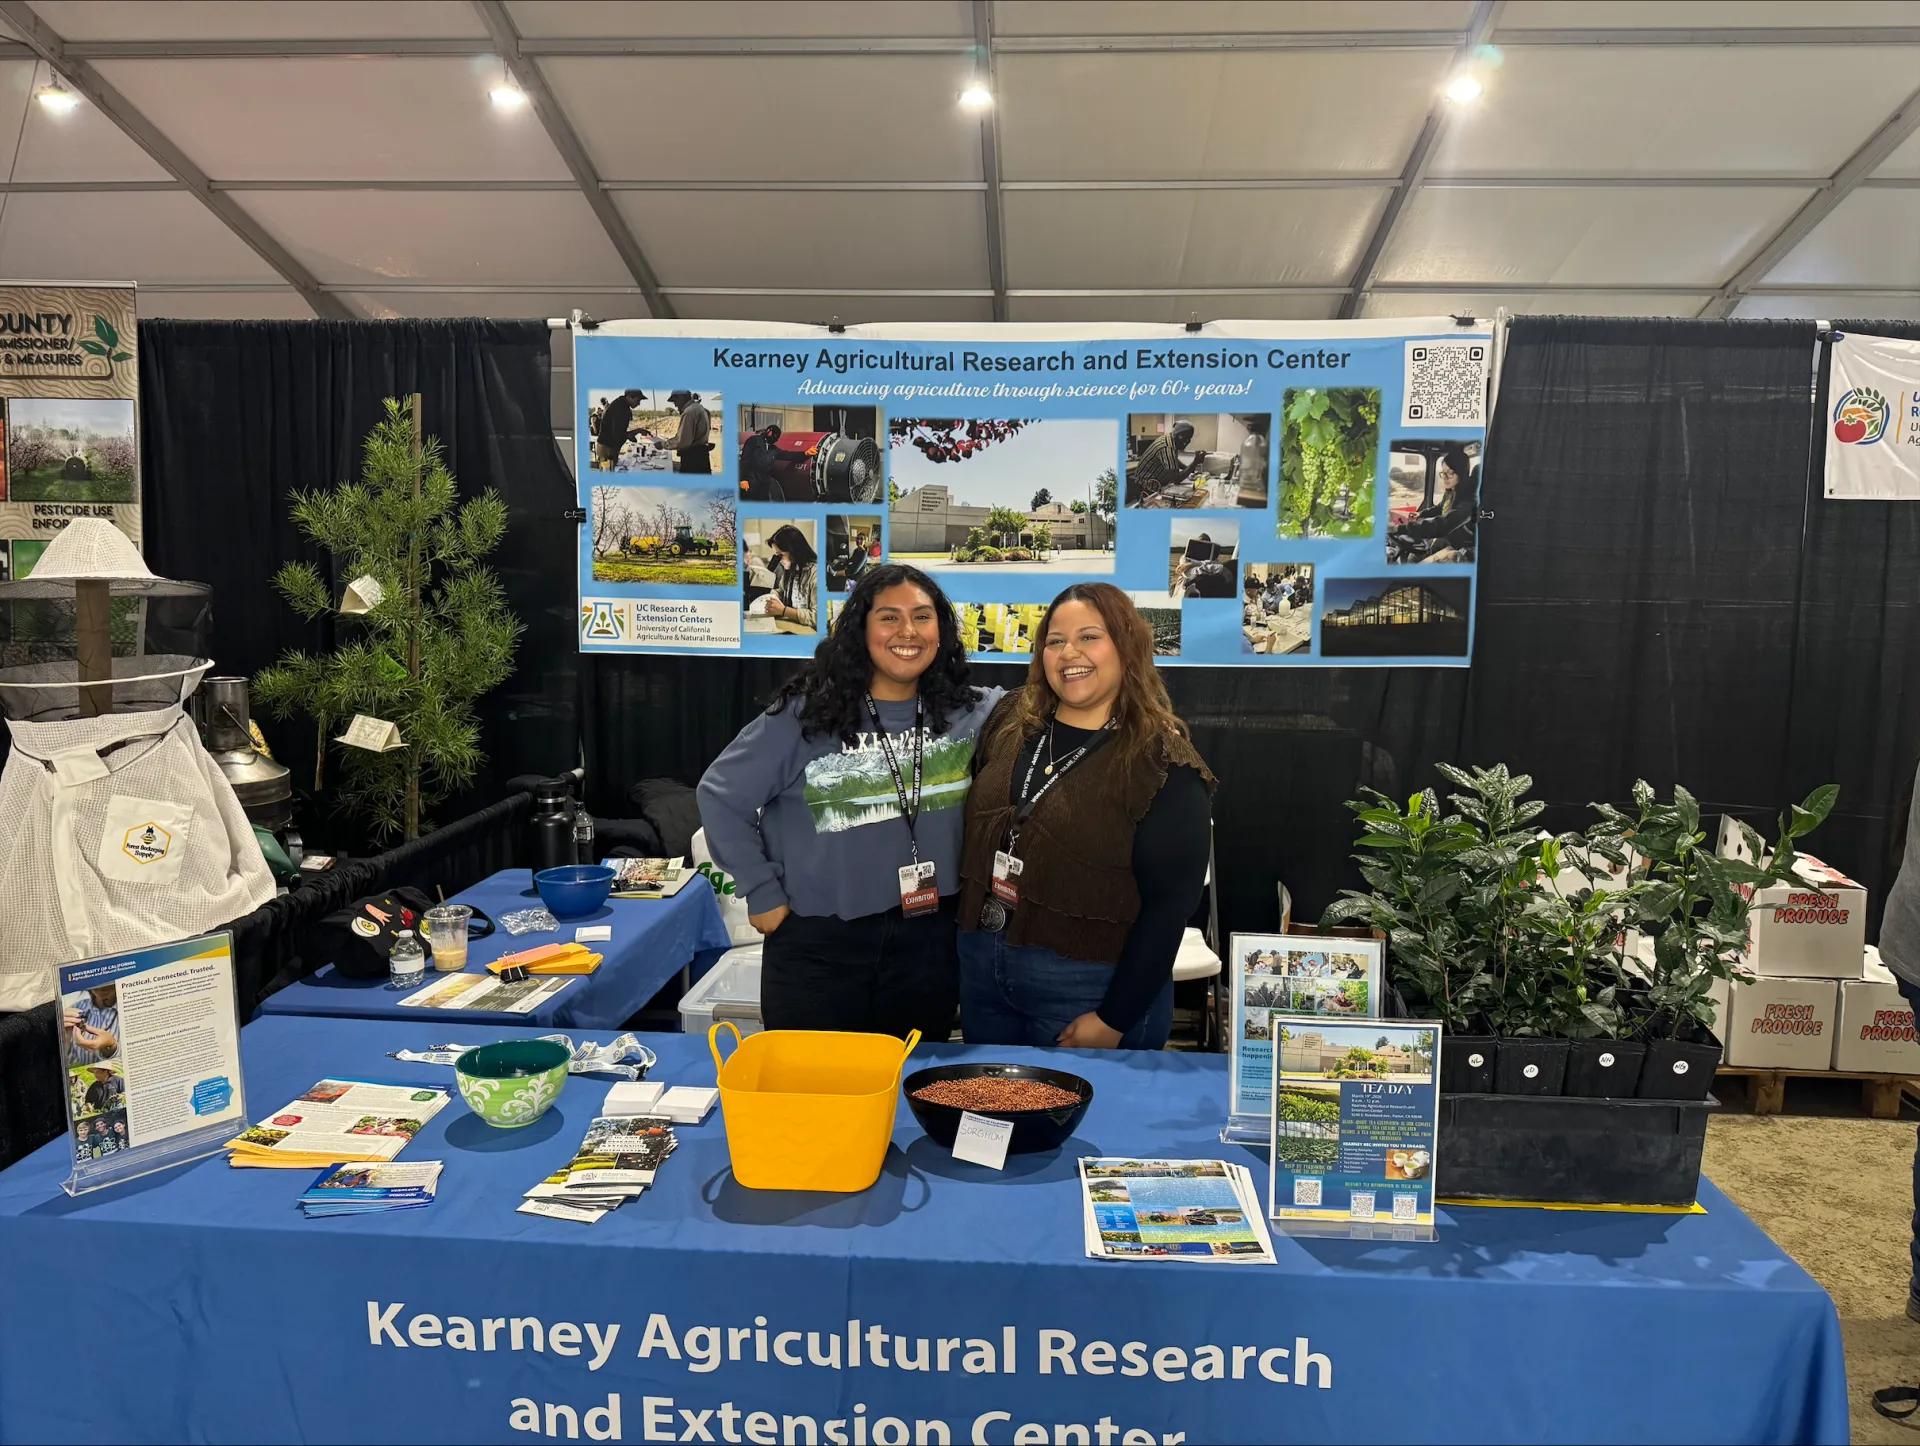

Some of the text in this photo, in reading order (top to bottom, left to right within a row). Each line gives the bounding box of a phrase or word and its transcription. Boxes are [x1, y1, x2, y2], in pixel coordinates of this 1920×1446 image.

[4, 353, 83, 366] & MEASURES
[713, 347, 1351, 374] Kearney Agricultural Research and Extension Center
[796, 378, 1254, 402] Advancing agriculture through science for 60+ years!
[34, 504, 114, 516] PESTICIDE USE
[636, 603, 697, 613] UC Research &
[636, 613, 713, 624] Extension Centers
[636, 624, 711, 634] University of California
[636, 633, 740, 643] Agriculture & Natural Resources
[126, 842, 140, 850] Forest
[134, 850, 155, 859] Supply
[905, 892, 935, 905] EXHIBITOR
[1787, 893, 1840, 909] FRESH
[1774, 909, 1849, 924] PRODUCE
[121, 964, 216, 989] Practical. Connected. Trusted.
[1764, 1003, 1815, 1019] FRESH
[1873, 1010, 1915, 1025] FRES
[1752, 1018, 1823, 1036] PRODUCE
[1860, 1025, 1920, 1042] PRODUC
[1242, 1052, 1273, 1060] happenin
[1360, 1083, 1414, 1095] TEA DAY
[960, 1123, 1004, 1143] SORGHUM
[366, 1300, 1333, 1389] Kearney Agricultural Research
[508, 1392, 623, 1441] and
[642, 1394, 951, 1446] Extension
